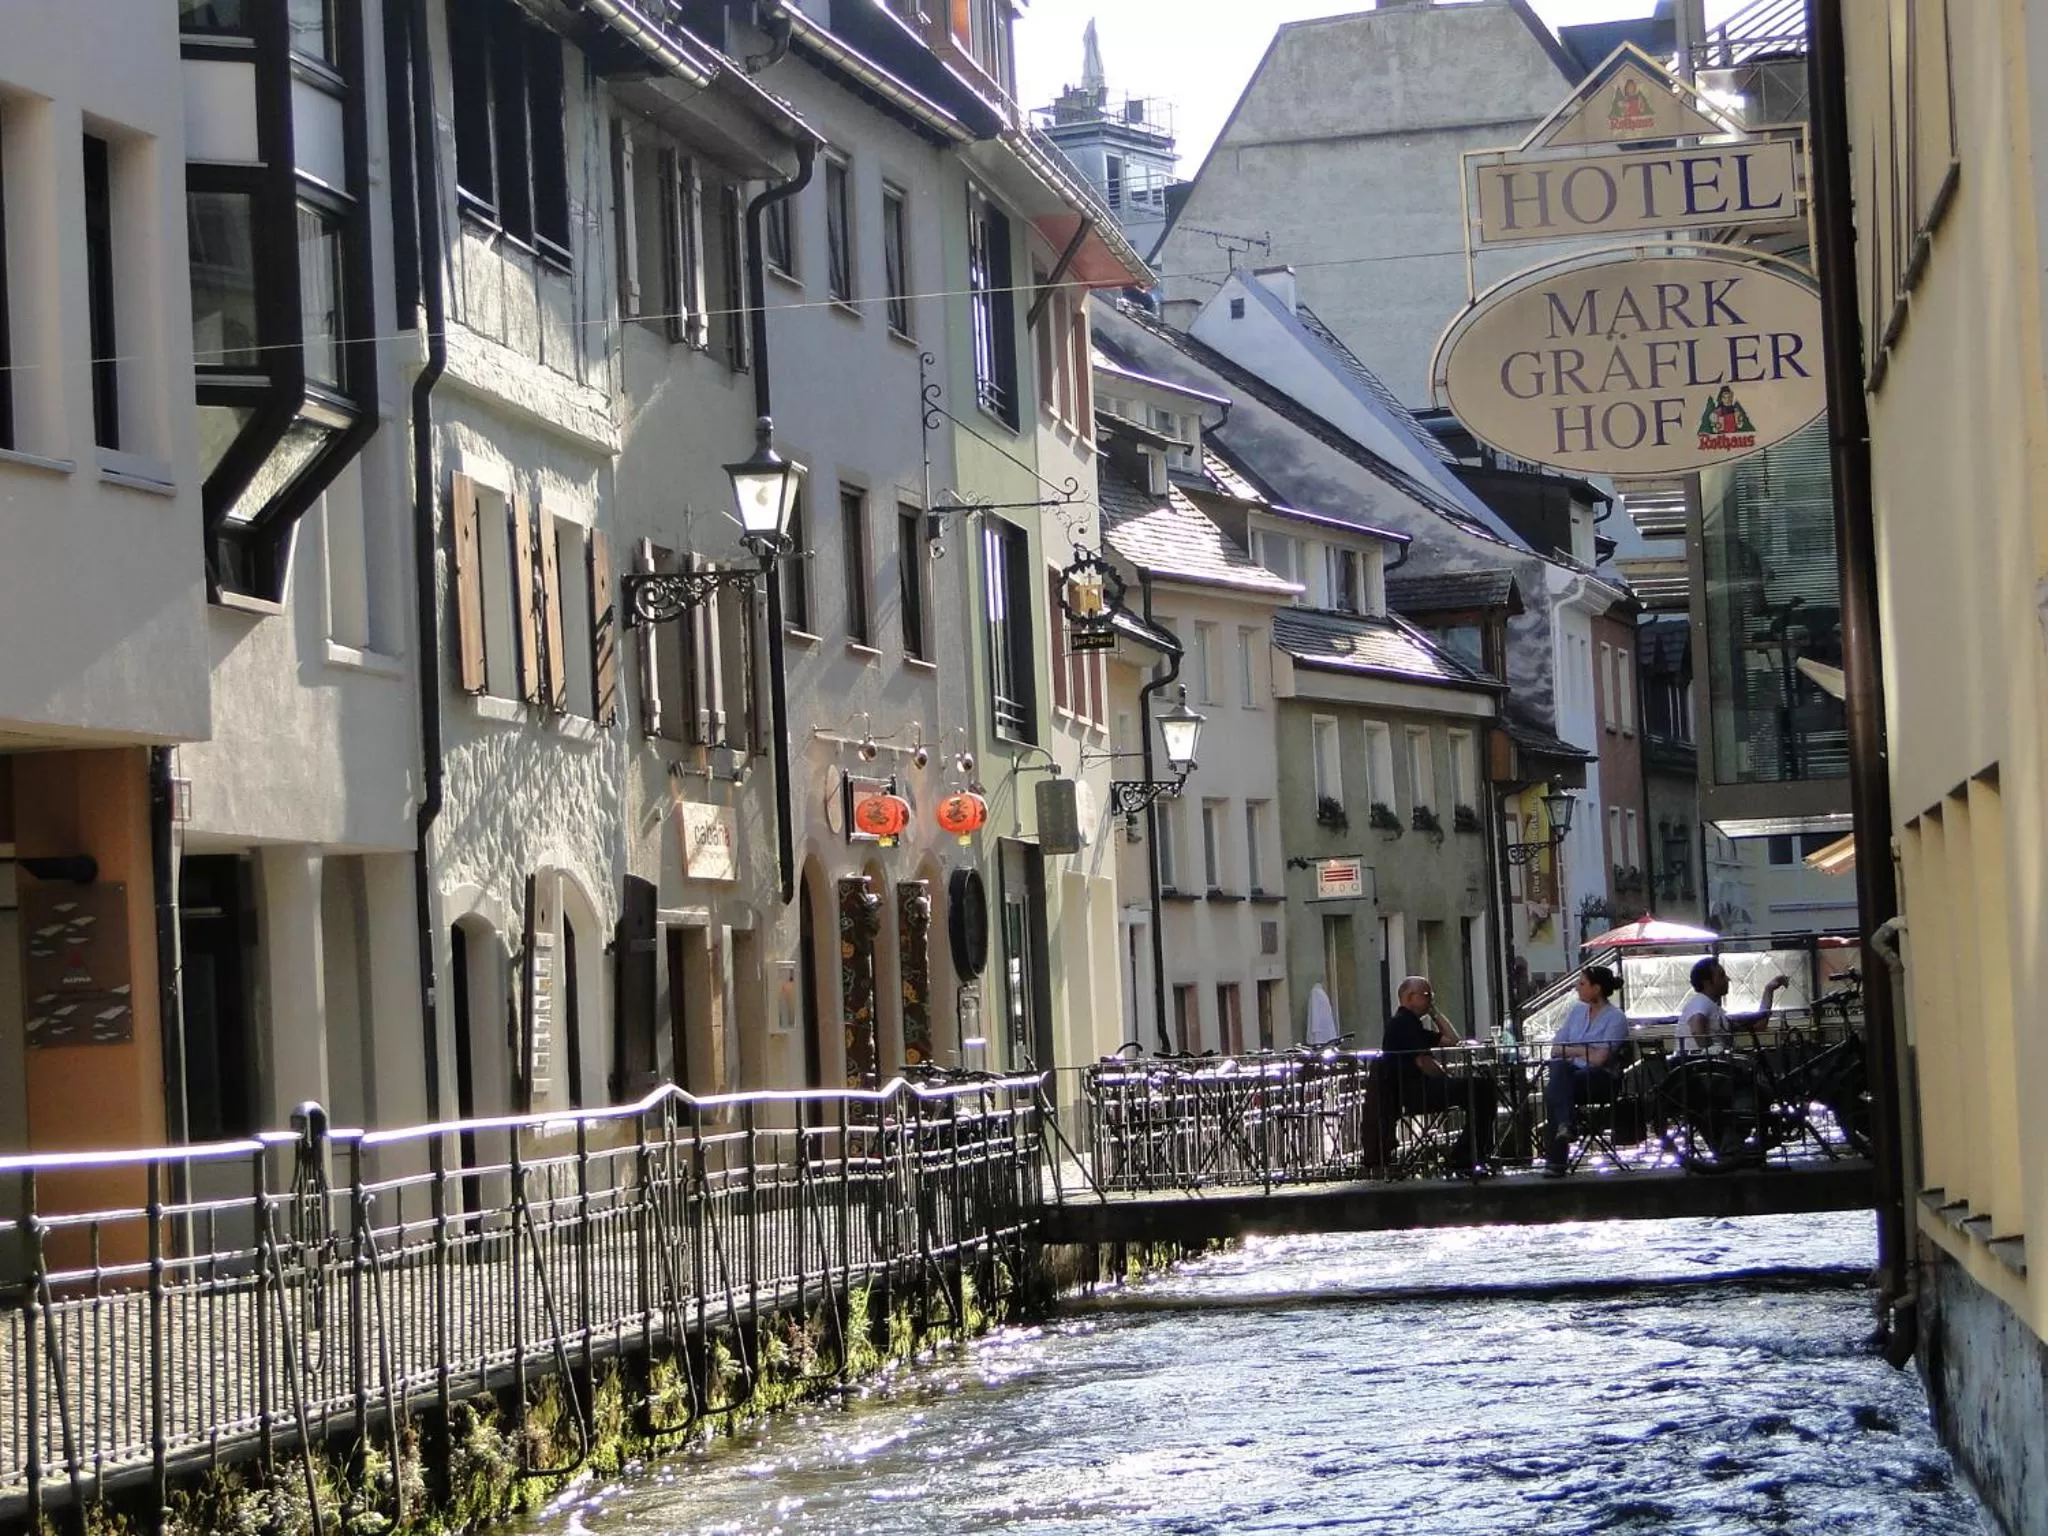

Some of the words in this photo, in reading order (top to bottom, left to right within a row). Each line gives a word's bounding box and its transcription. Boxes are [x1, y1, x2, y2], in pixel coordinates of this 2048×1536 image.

[1496, 153, 1783, 230] HOTEL
[1543, 278, 1748, 339] MARK
[1500, 331, 1812, 400] GRÄFLER
[1550, 398, 1686, 455] HOF
[1697, 433, 1755, 451] Rothaus
